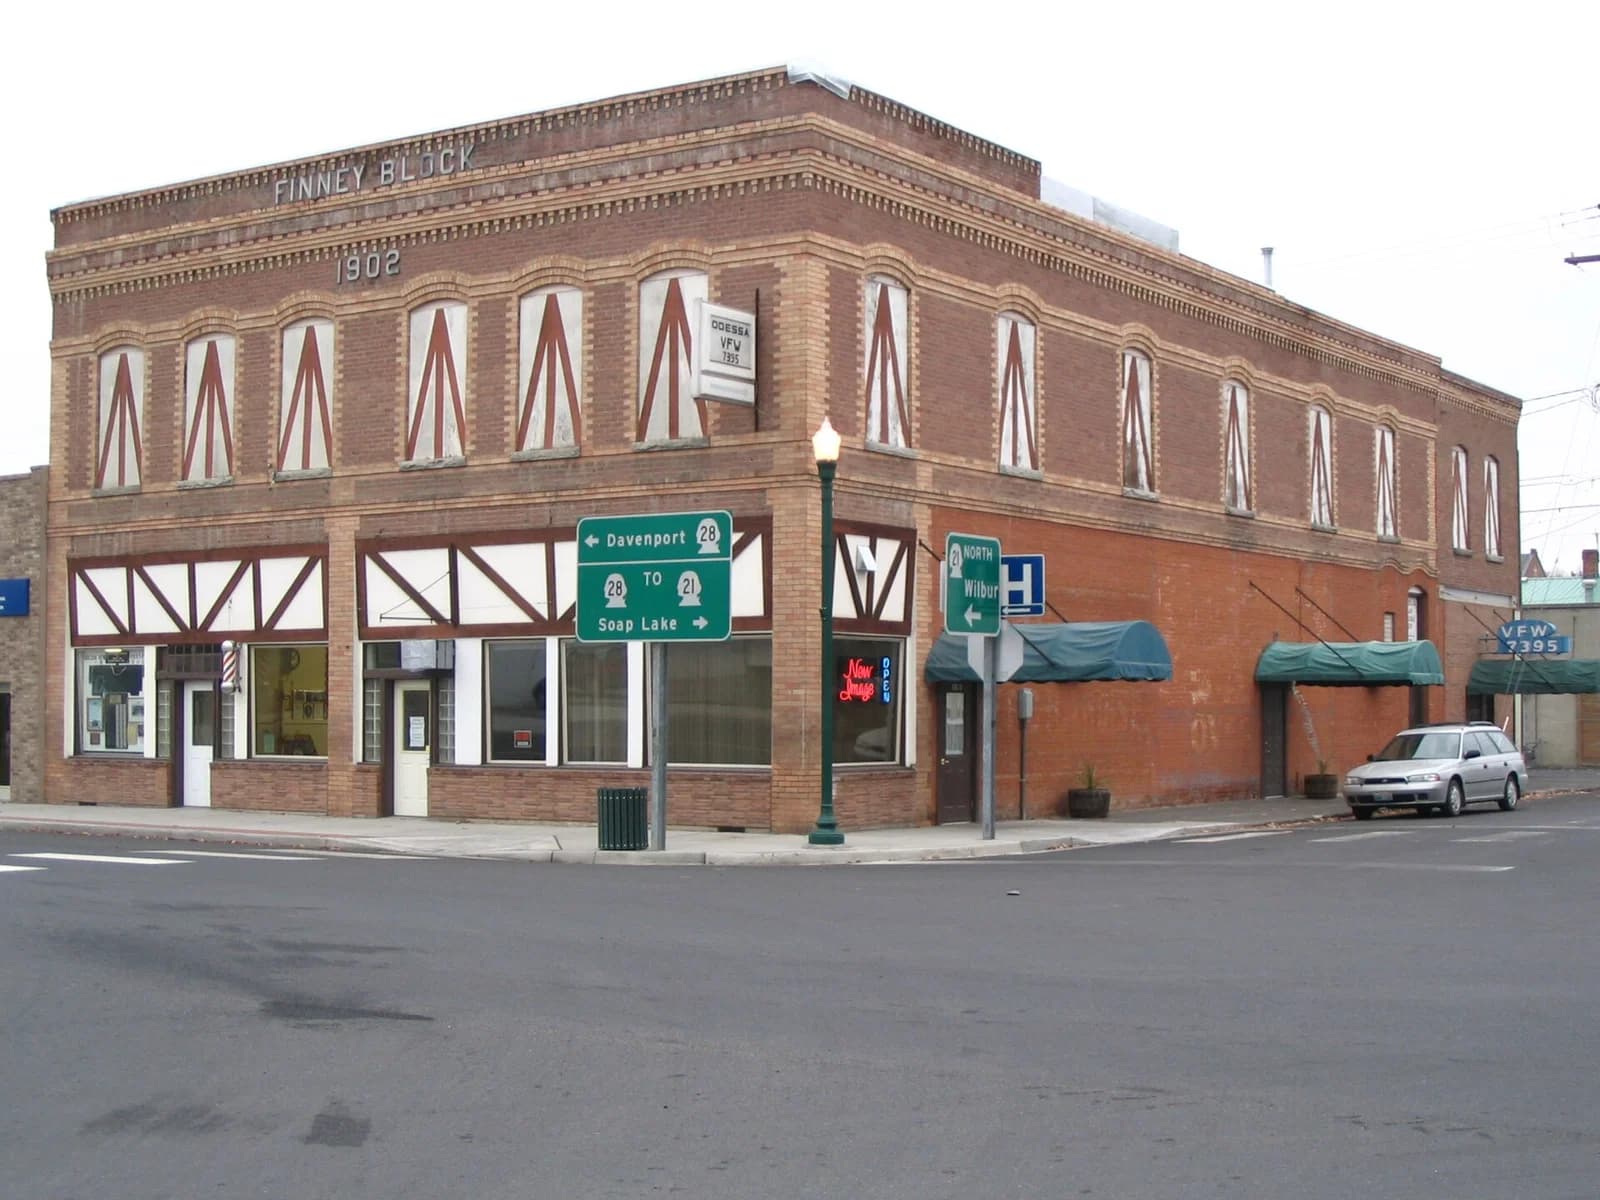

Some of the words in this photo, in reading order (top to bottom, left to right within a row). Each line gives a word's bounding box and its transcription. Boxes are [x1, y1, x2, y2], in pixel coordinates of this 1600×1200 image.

[275, 165, 365, 204] FINNEY
[380, 144, 475, 186] BLOCK
[336, 250, 401, 284] 1902
[711, 320, 750, 338] ODESSA
[720, 335, 742, 352] VFW
[722, 351, 740, 365] 7395
[607, 530, 686, 547] Davenport
[700, 525, 716, 542] 28
[952, 550, 960, 567] 21
[963, 544, 993, 561] NORTH
[607, 580, 623, 597] 28
[643, 571, 662, 586] TO
[682, 578, 695, 595] 21
[964, 578, 998, 599] Wilbur
[1000, 563, 1032, 606] H
[598, 617, 634, 633] Soap
[641, 616, 678, 631] Lake
[1501, 624, 1548, 638] VFW
[1506, 639, 1558, 653] 7395
[842, 658, 874, 679] New
[882, 657, 890, 703] OPEN
